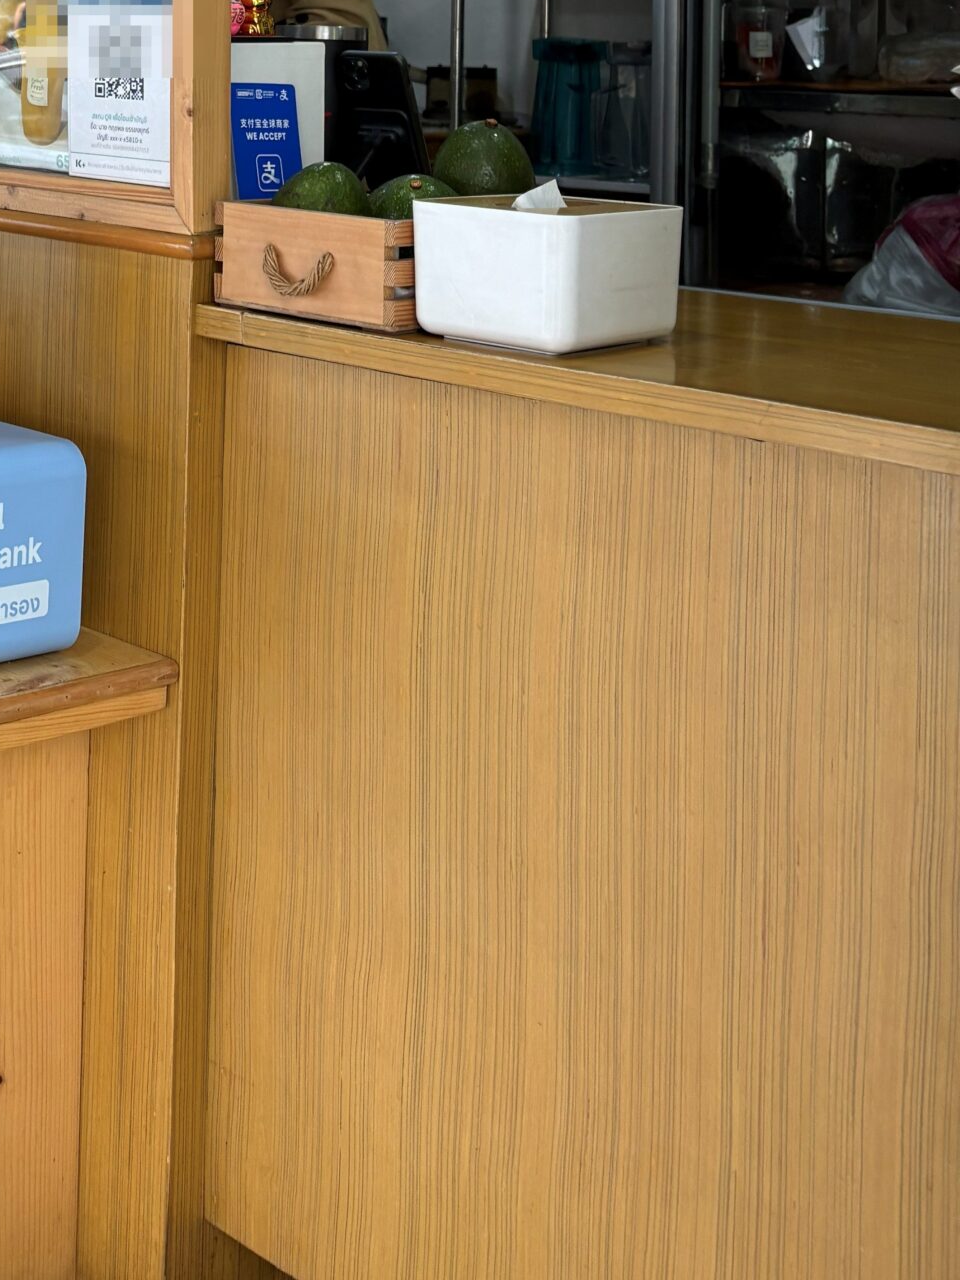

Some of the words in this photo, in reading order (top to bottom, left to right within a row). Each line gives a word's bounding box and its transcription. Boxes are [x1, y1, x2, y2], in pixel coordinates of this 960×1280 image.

[239, 118, 290, 129] 支付宝全球商家
[246, 132, 258, 141] WE
[259, 132, 286, 141] ACCEPT
